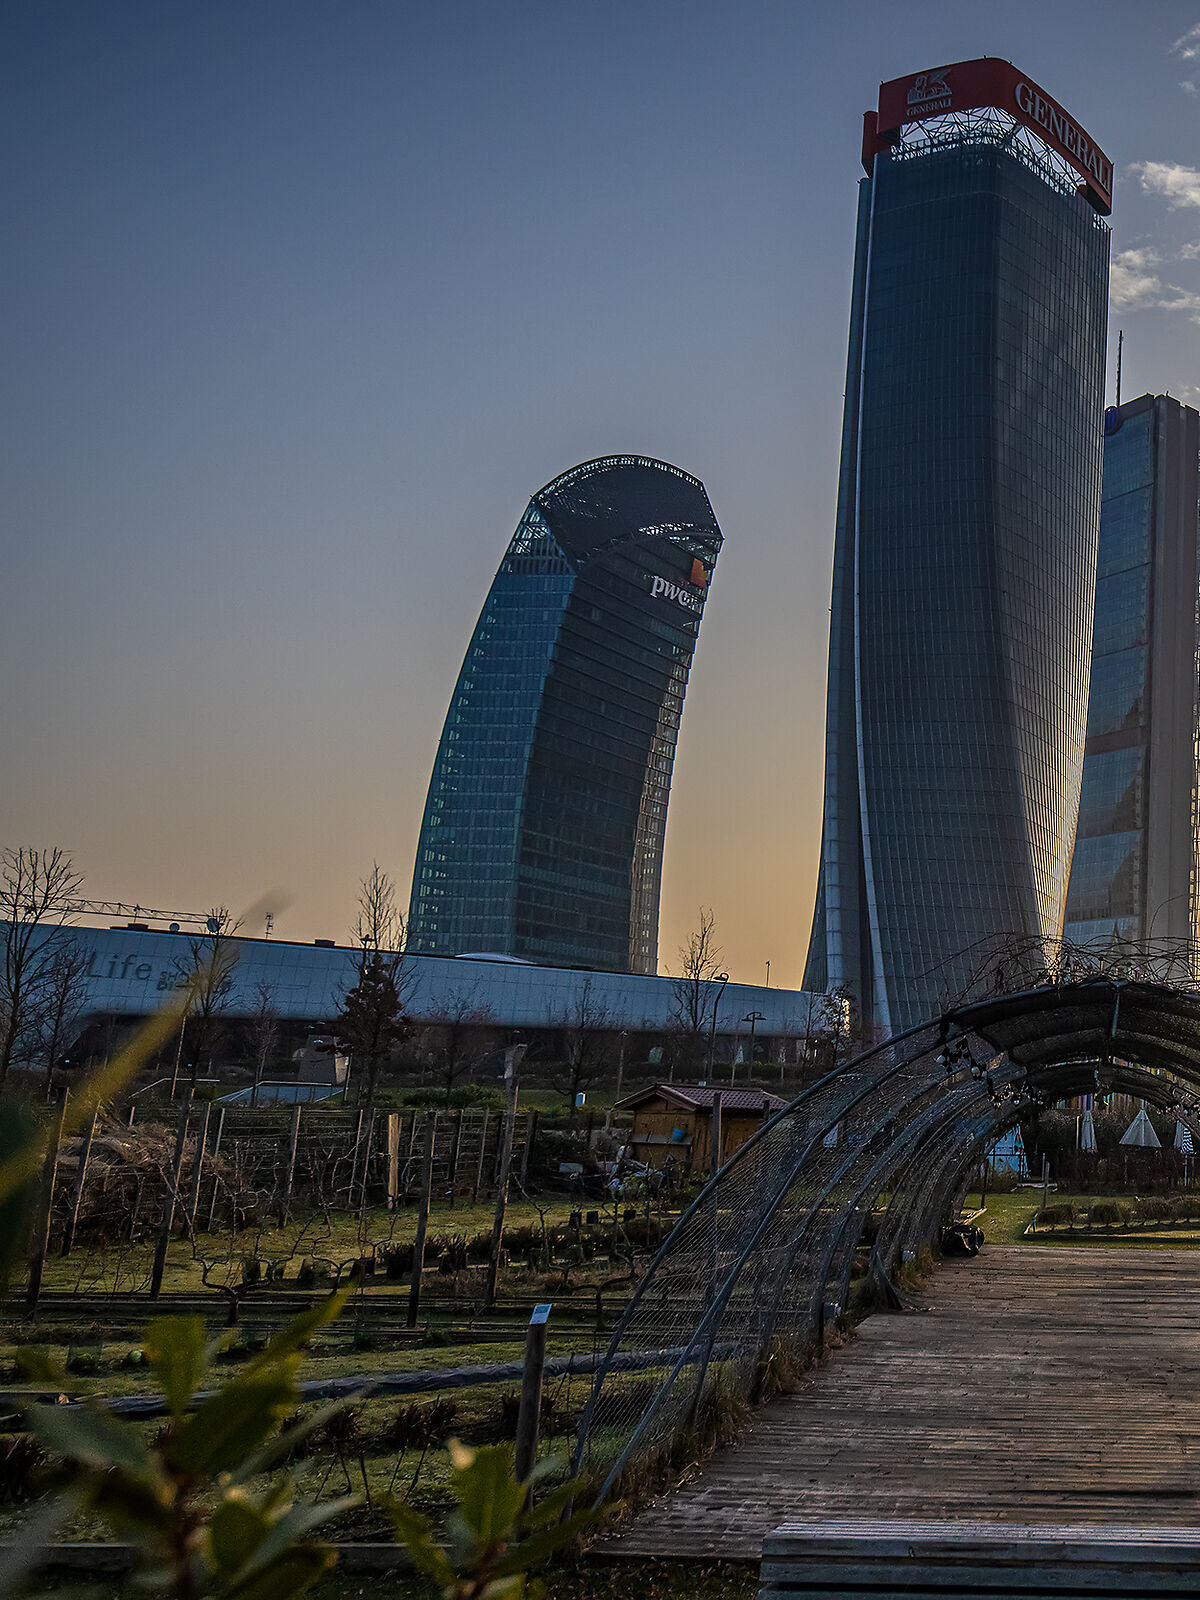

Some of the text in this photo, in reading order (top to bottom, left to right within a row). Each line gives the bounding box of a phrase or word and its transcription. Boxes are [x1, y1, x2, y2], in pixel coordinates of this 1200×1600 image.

[906, 99, 951, 117] GENERALI
[1015, 82, 1111, 195] GENERALI
[650, 576, 690, 606] pwc
